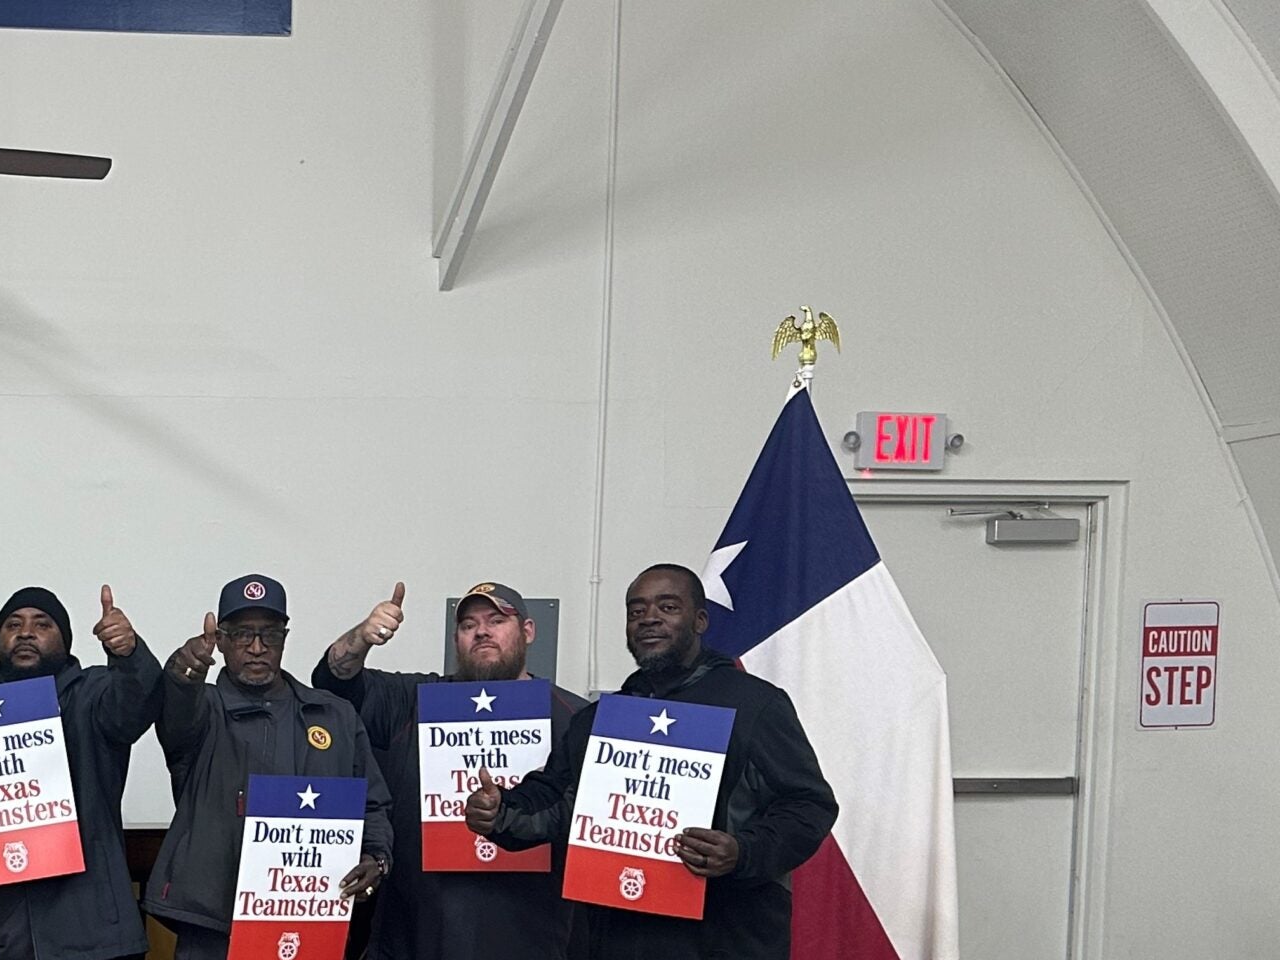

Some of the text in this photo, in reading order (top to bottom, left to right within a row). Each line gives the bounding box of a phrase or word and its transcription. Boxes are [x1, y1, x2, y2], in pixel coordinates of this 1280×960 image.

[875, 414, 936, 463] EXIT
[1148, 629, 1213, 654] CAUTION
[1144, 665, 1212, 707] STEP
[2, 728, 55, 752] mess
[428, 726, 543, 748] Don't mess
[461, 747, 509, 769] with
[594, 740, 713, 781] Don't mess
[451, 769, 520, 794] Teas
[624, 773, 671, 801] with
[607, 792, 680, 830] Texas
[252, 820, 355, 845] Don't mess
[575, 814, 677, 857] Teamste
[281, 846, 323, 868] with
[267, 867, 330, 893] Texas
[238, 891, 350, 917] Teamsters
